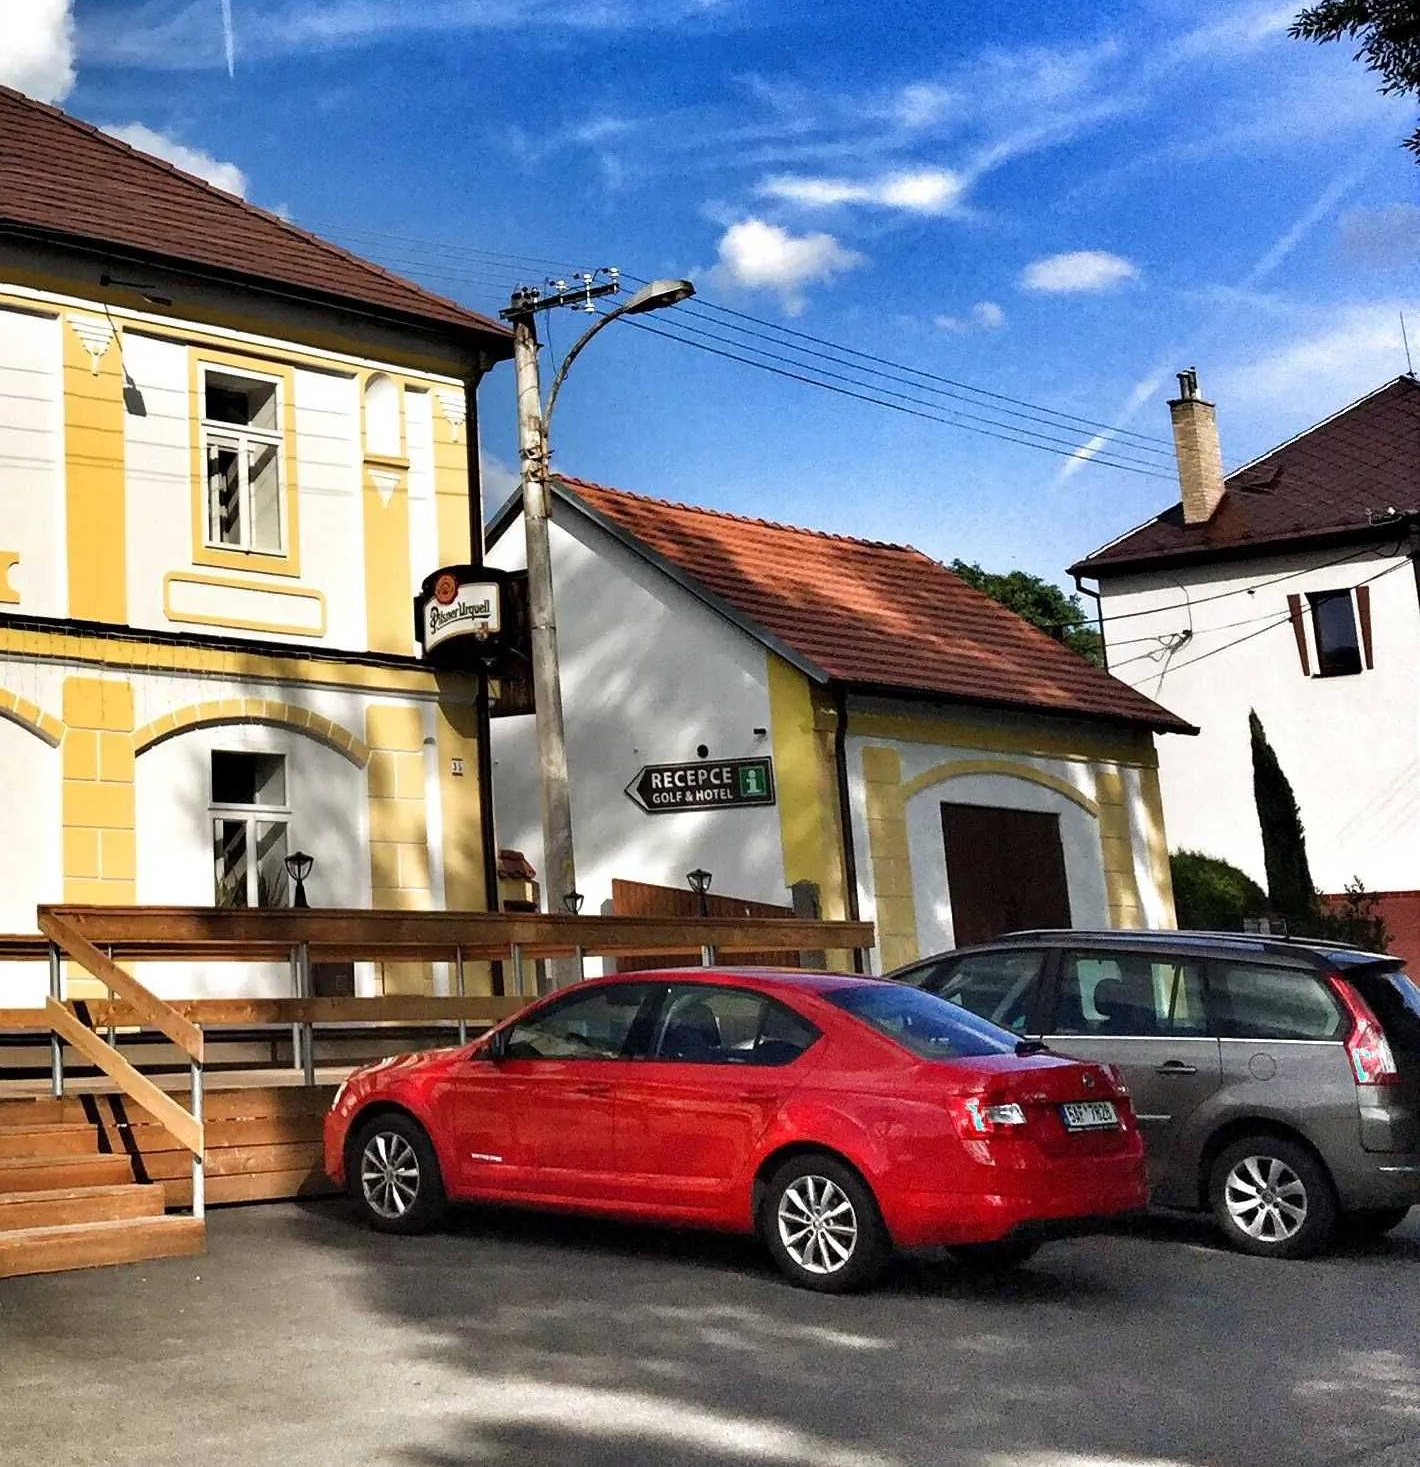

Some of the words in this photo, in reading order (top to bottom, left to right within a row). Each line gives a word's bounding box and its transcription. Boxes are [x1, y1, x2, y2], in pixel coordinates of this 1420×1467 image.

[429, 606, 459, 635] Pilsner
[458, 599, 490, 621] Urquell
[651, 767, 733, 789] RECEPCE
[652, 791, 683, 804] GOLF
[685, 790, 694, 803] &
[695, 789, 734, 802] HOTEL
